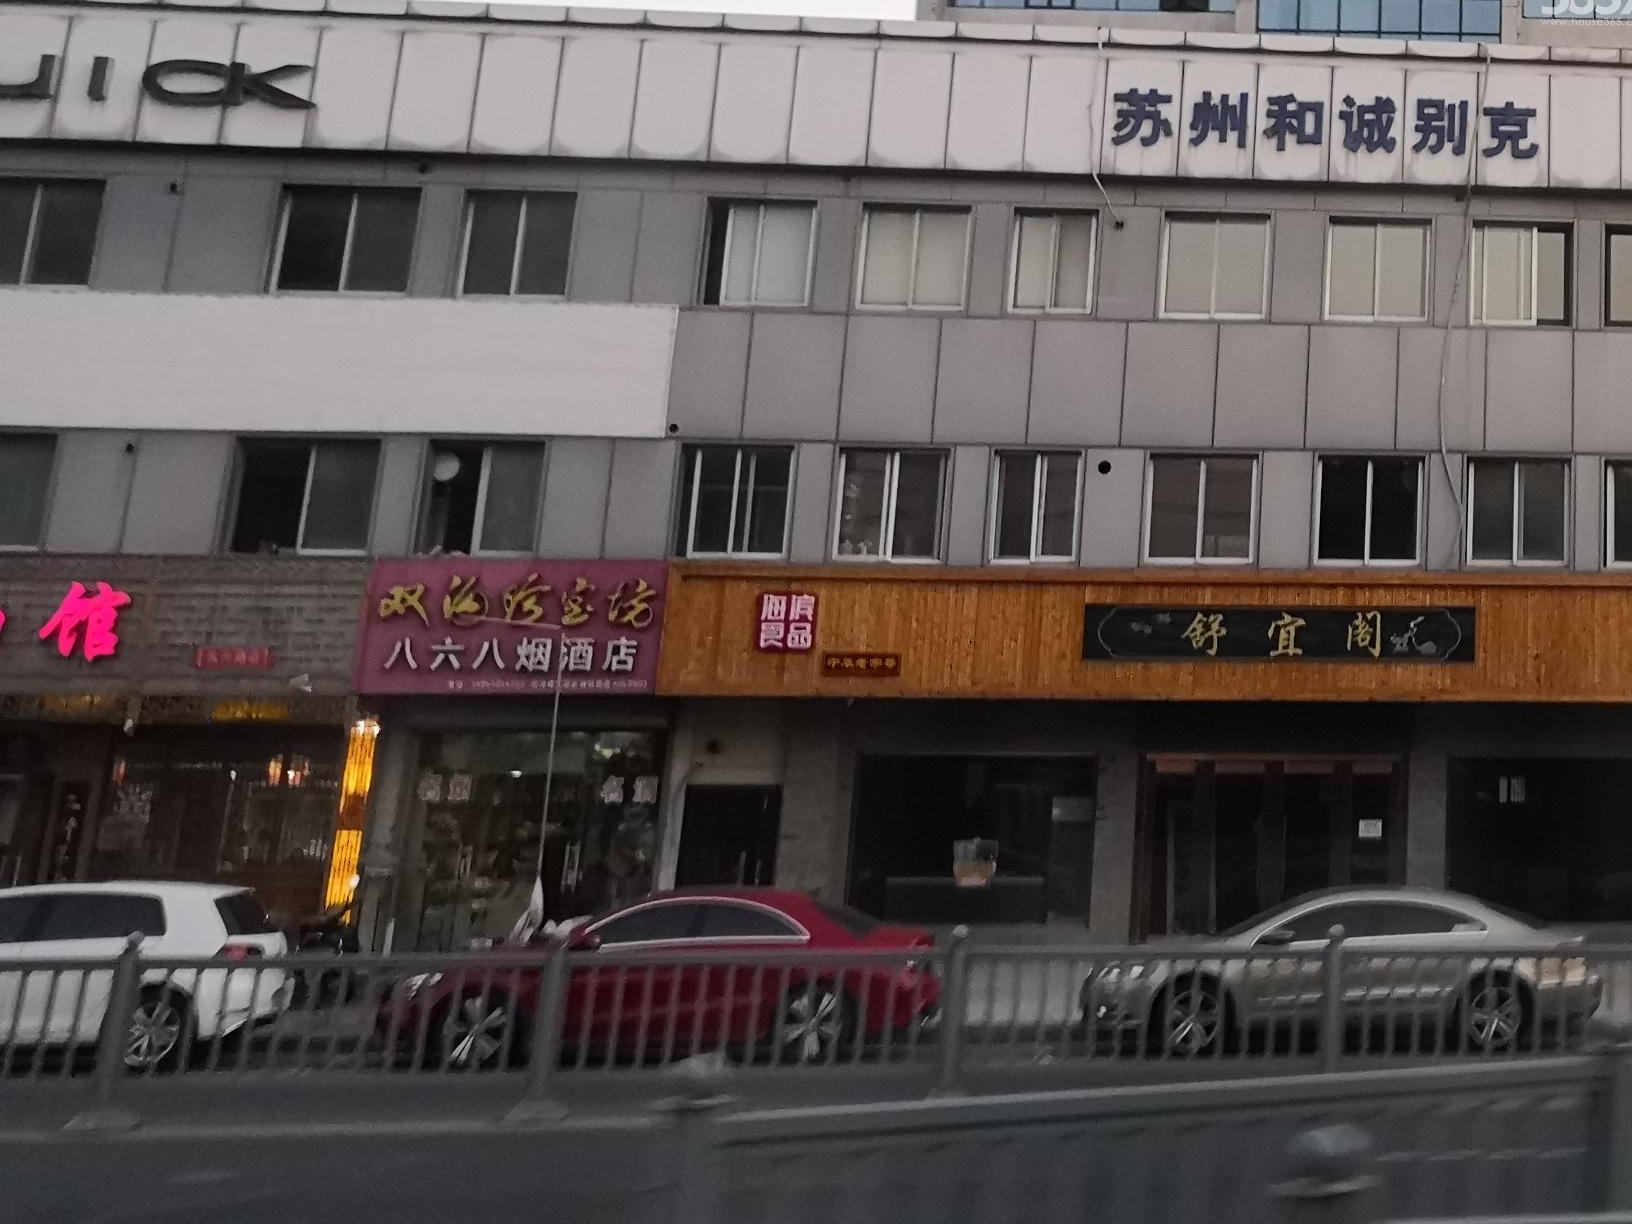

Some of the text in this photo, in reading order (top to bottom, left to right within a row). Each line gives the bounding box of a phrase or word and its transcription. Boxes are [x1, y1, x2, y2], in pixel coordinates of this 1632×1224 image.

[1111, 88, 1540, 160] 苏州和诚别克
[0, 580, 132, 663] 馆
[384, 636, 638, 673] 八六八烟酒店
